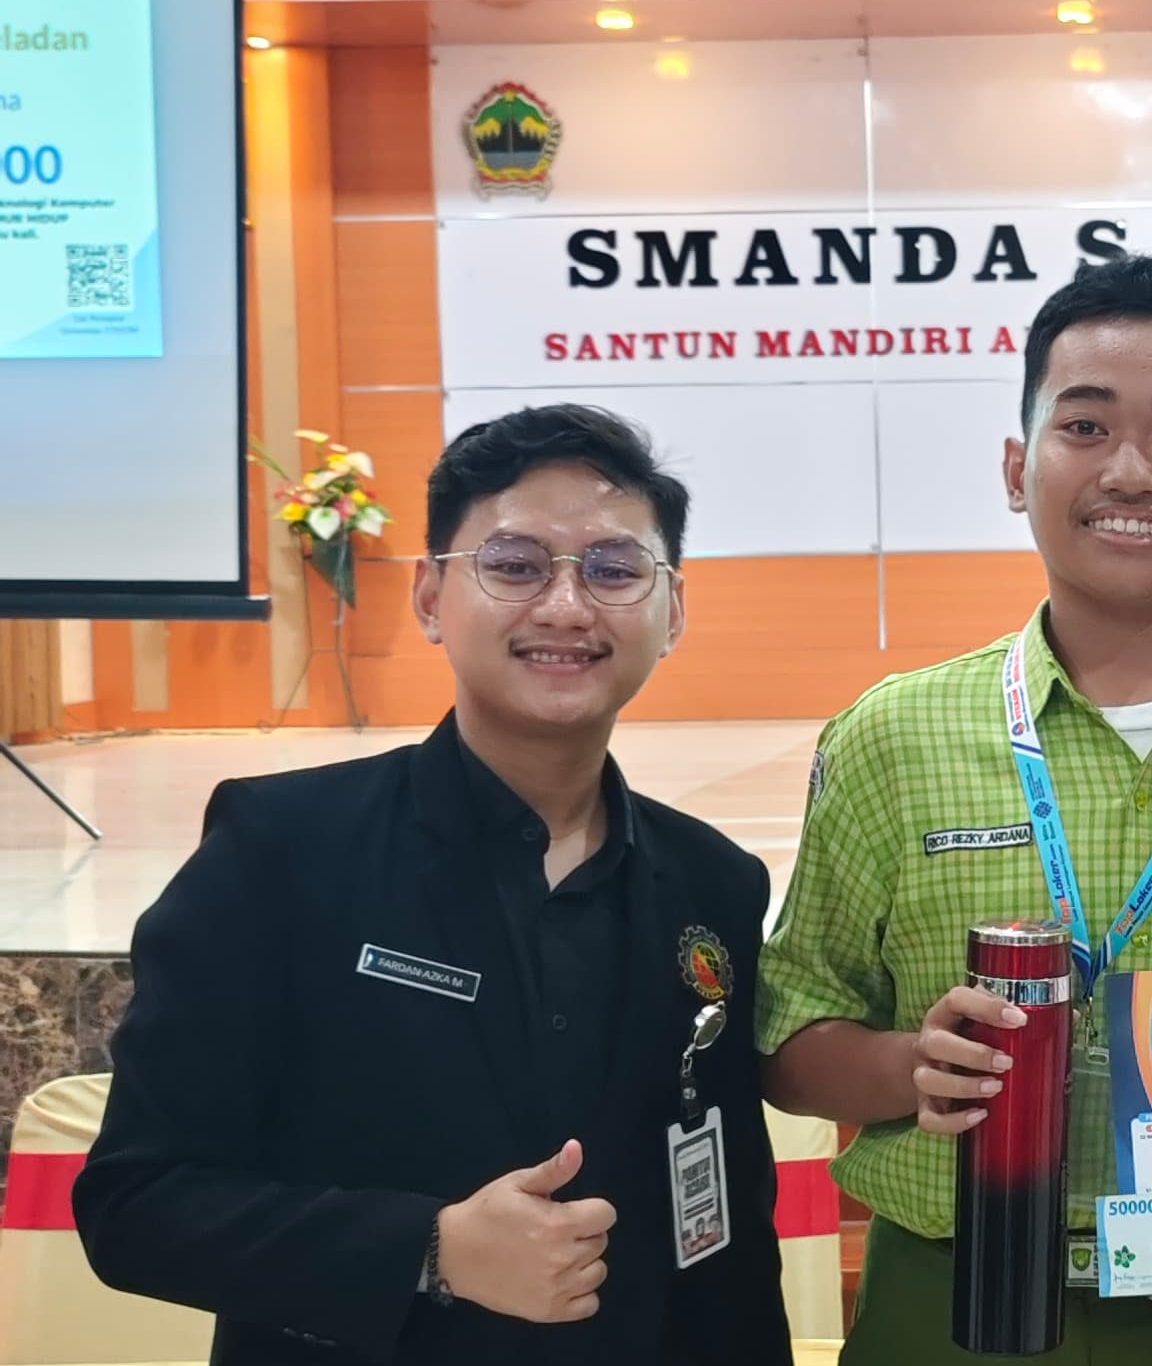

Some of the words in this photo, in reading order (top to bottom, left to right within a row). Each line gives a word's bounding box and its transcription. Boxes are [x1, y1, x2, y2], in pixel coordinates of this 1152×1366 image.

[0, 23, 89, 52] ladan
[567, 224, 1038, 289] SMANDA
[545, 331, 737, 361] SANTUN
[755, 327, 972, 358] MANDIRI
[987, 829, 1030, 843] ARDANA
[378, 957, 421, 977] FARDAN
[421, 970, 450, 985] AZKA
[451, 977, 464, 988] M
